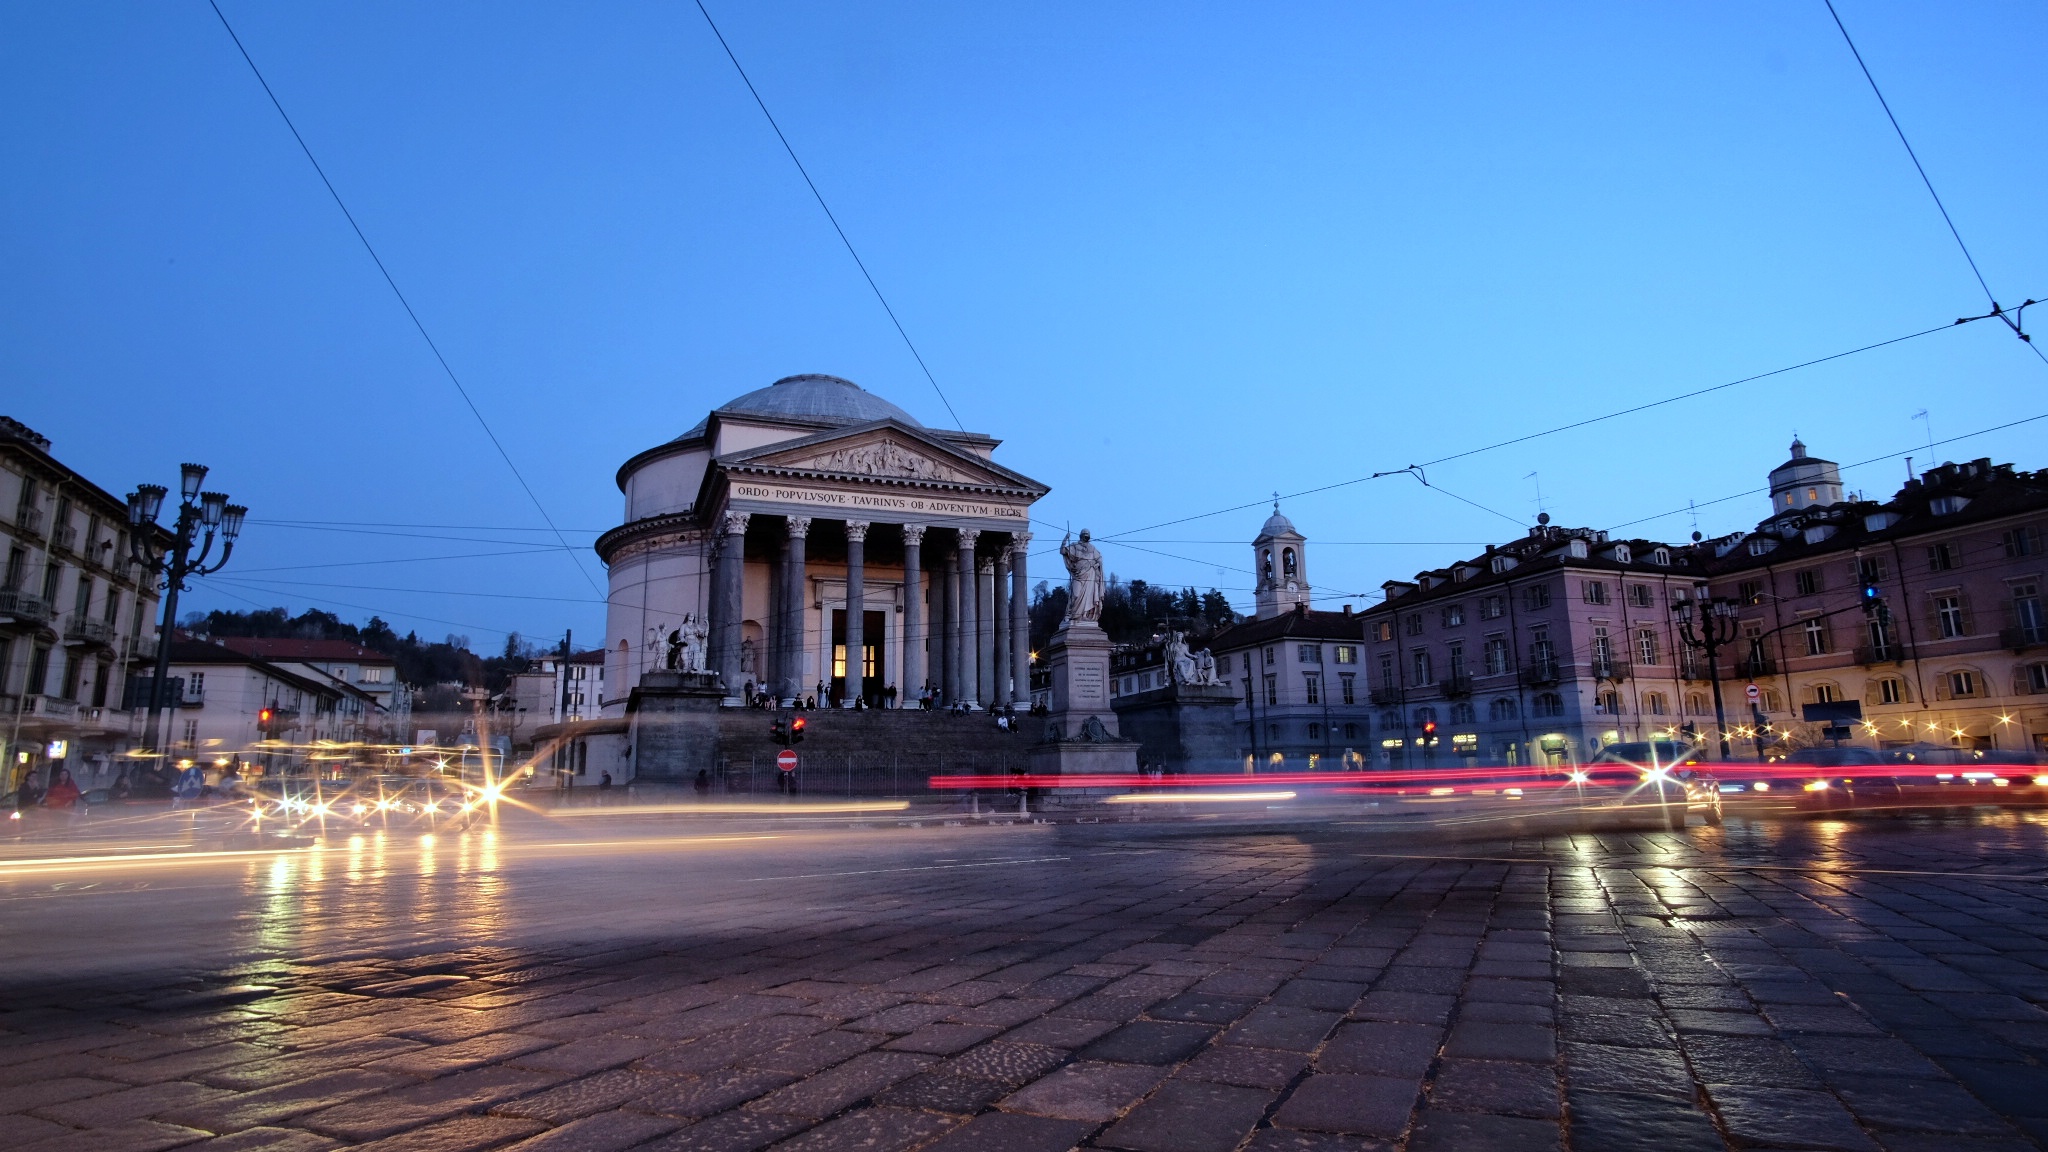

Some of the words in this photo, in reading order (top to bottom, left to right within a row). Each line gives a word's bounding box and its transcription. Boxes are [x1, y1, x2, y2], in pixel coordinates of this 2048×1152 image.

[738, 487, 769, 497] ORDO
[776, 489, 846, 503] POPVLVSQVE
[851, 495, 905, 508] TAVRINVS
[911, 501, 924, 509] OB
[929, 502, 988, 515] ADVENTVM
